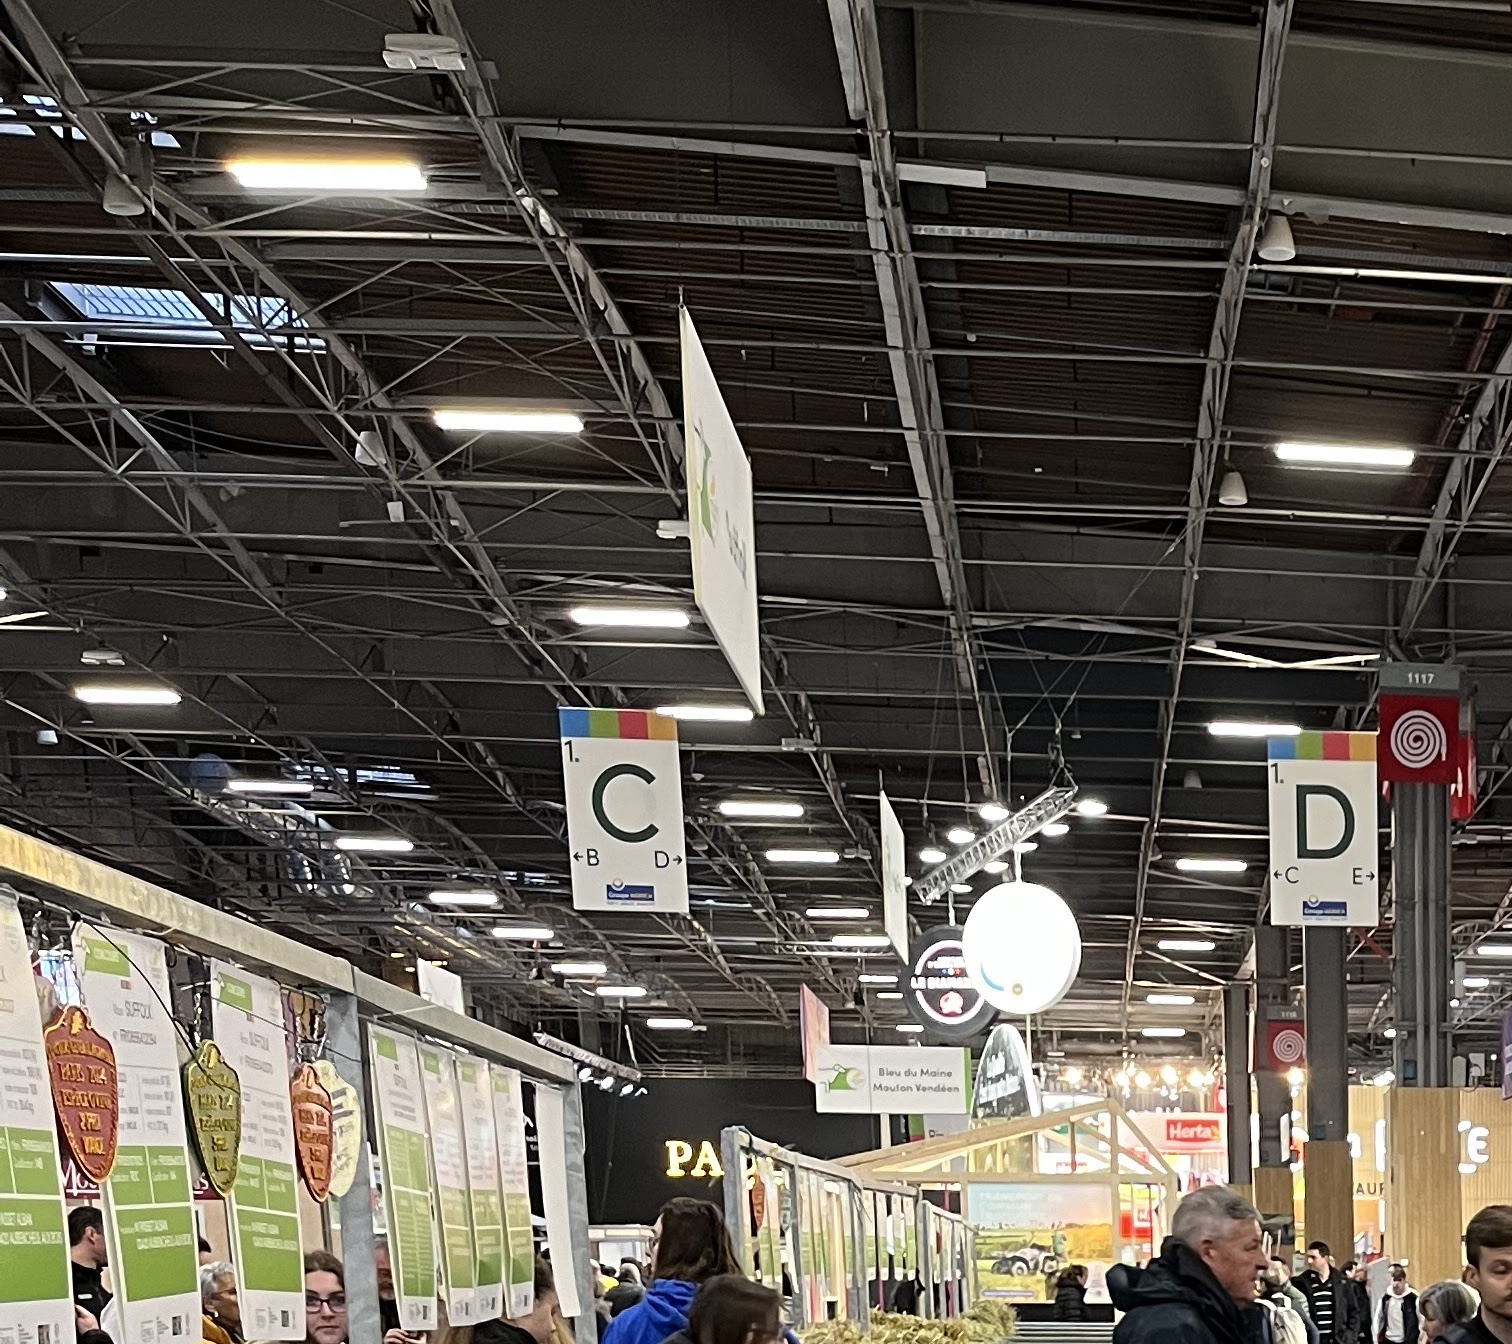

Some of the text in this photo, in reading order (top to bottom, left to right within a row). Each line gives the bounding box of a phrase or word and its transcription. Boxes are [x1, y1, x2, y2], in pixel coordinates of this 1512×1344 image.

[1407, 672, 1435, 684] 1117
[564, 740, 579, 762] 1.
[1270, 763, 1284, 784] 1.
[592, 764, 659, 843] C
[1296, 784, 1355, 859] D
[587, 848, 669, 868] B D
[1285, 866, 1363, 885] C E
[879, 1067, 953, 1078] Bleu du Maine
[873, 1083, 960, 1093] Mouton Vendéen
[1169, 1121, 1212, 1139] Herta
